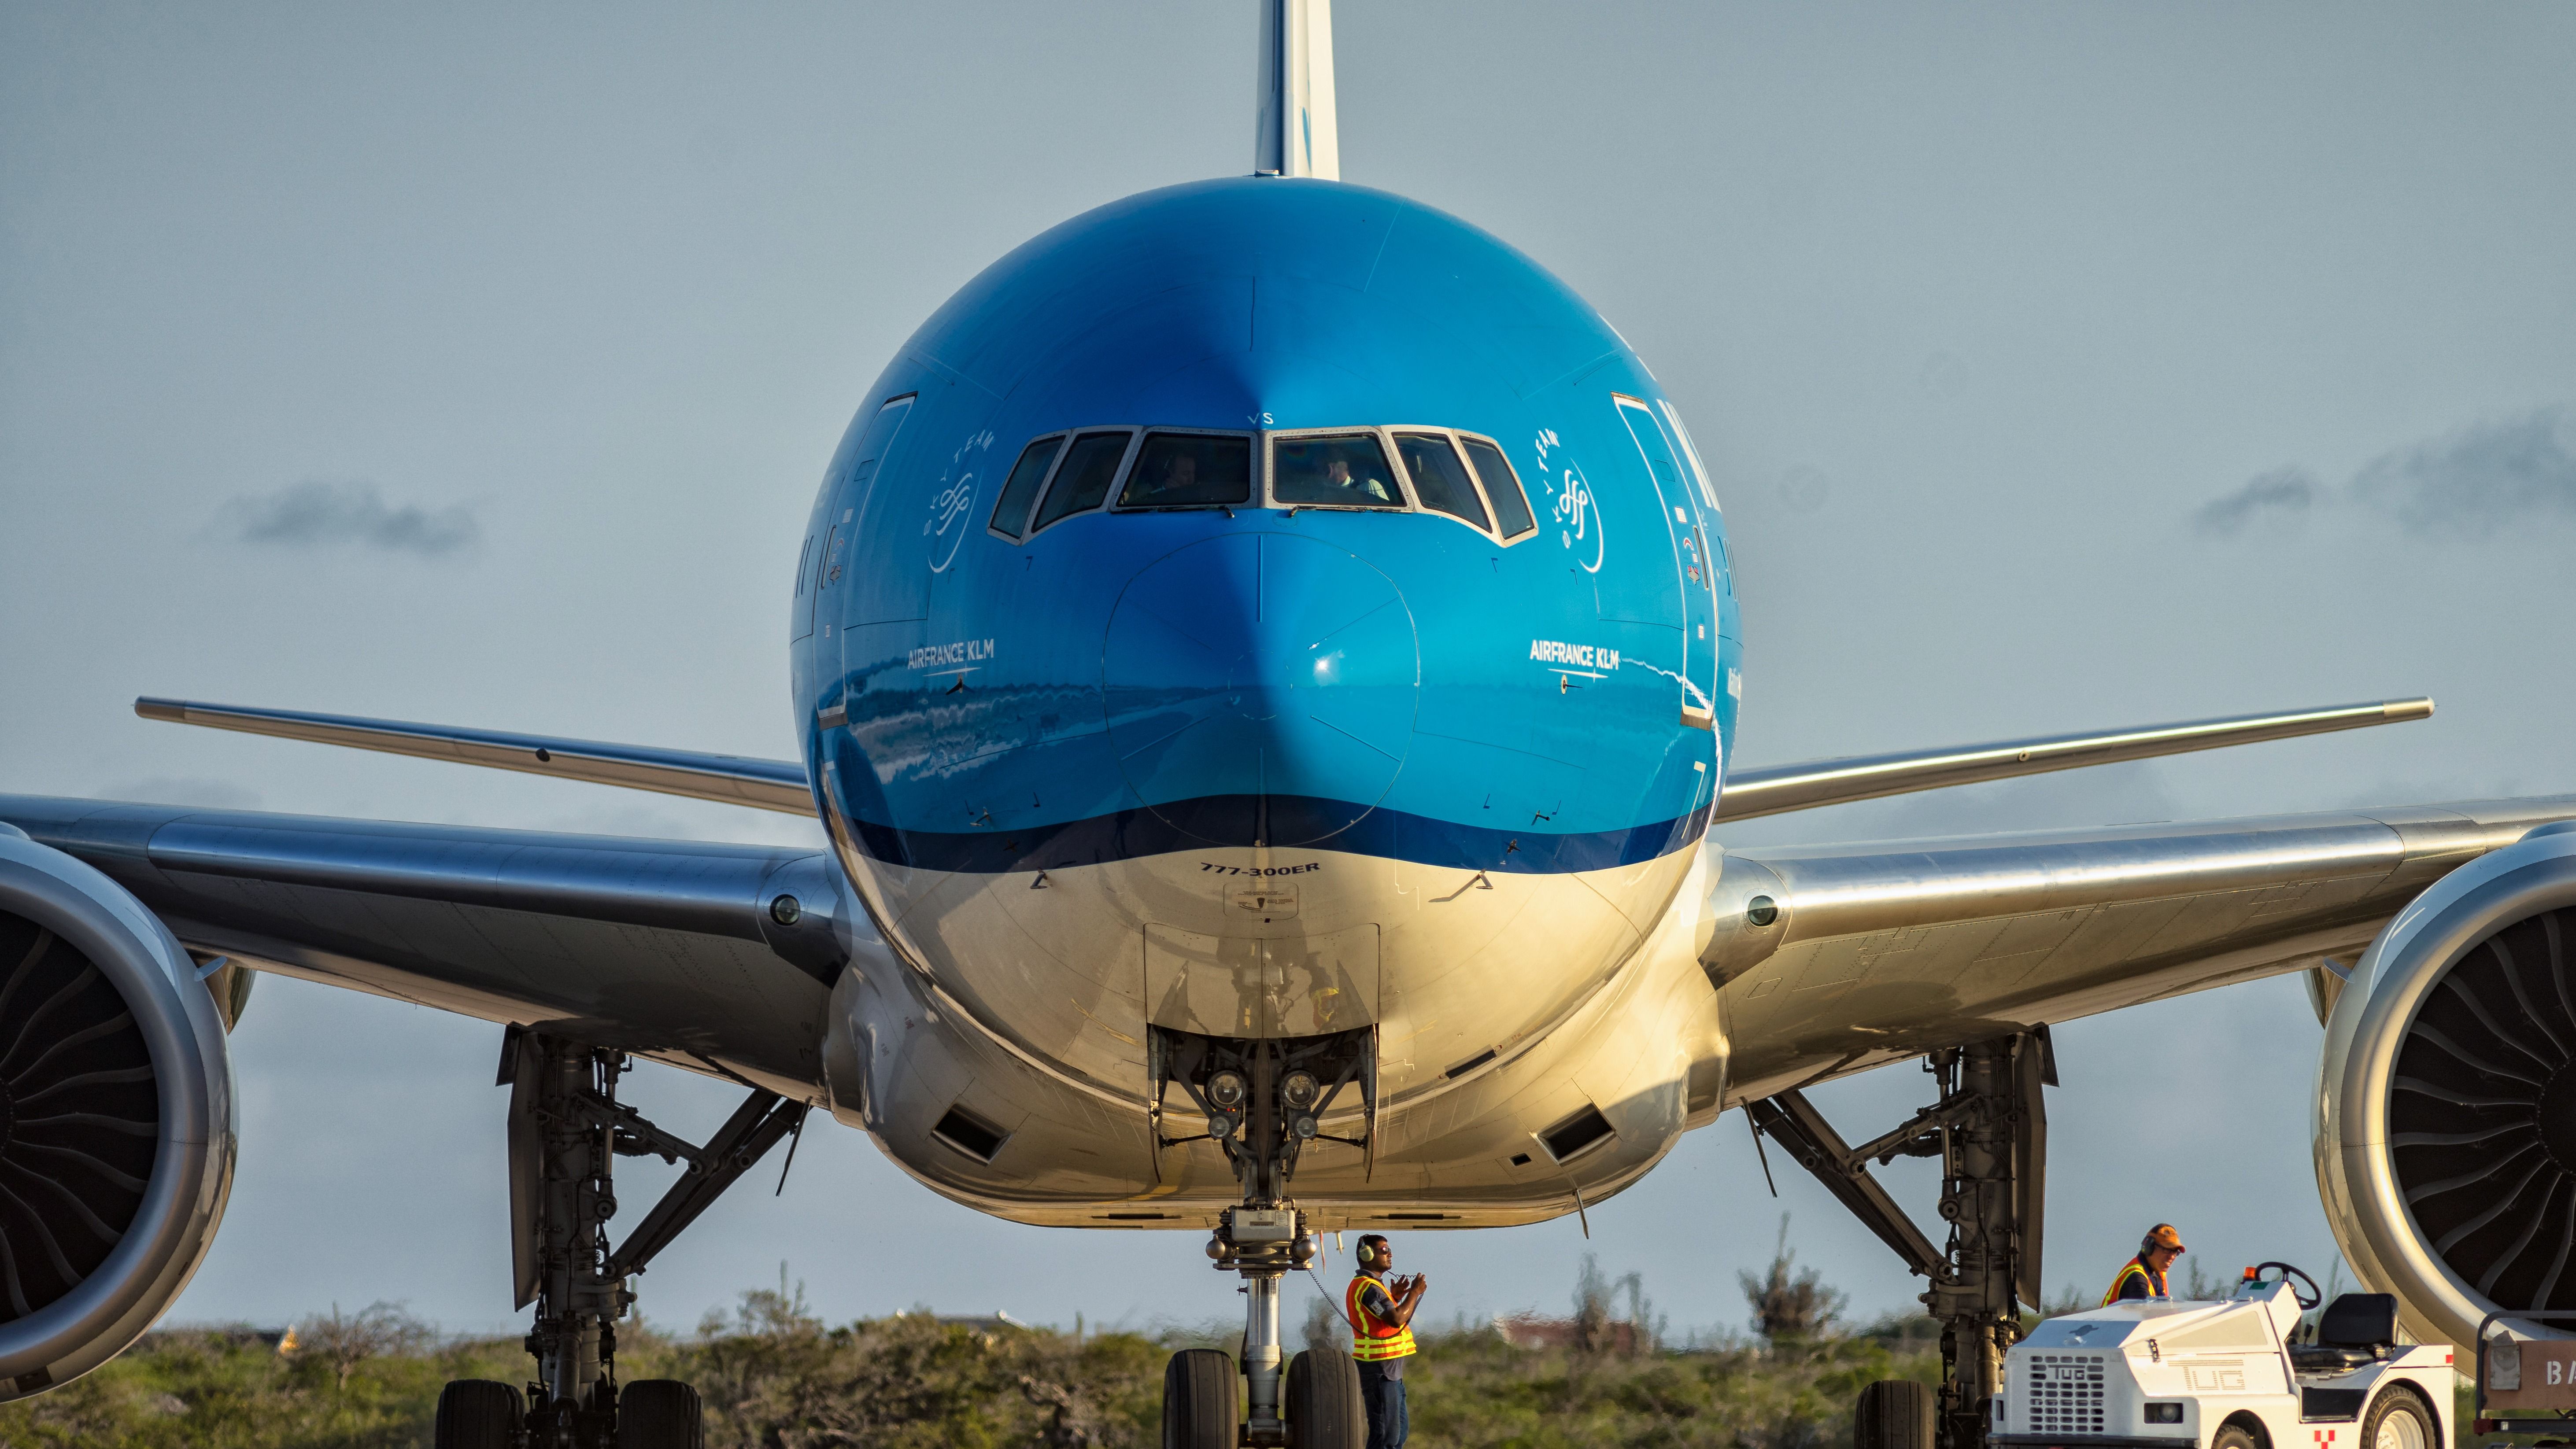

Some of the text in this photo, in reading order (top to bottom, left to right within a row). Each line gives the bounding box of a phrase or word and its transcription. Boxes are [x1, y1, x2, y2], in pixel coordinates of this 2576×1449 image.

[1247, 413, 1274, 424] VS
[908, 638, 994, 670] AIRFRANCE KLM
[1530, 640, 1619, 670] AIRFRANCE KLM
[1201, 862, 1320, 876] 777-300ER
[2048, 1365, 2086, 1380] TUG
[2167, 1360, 2246, 1390] TUG
